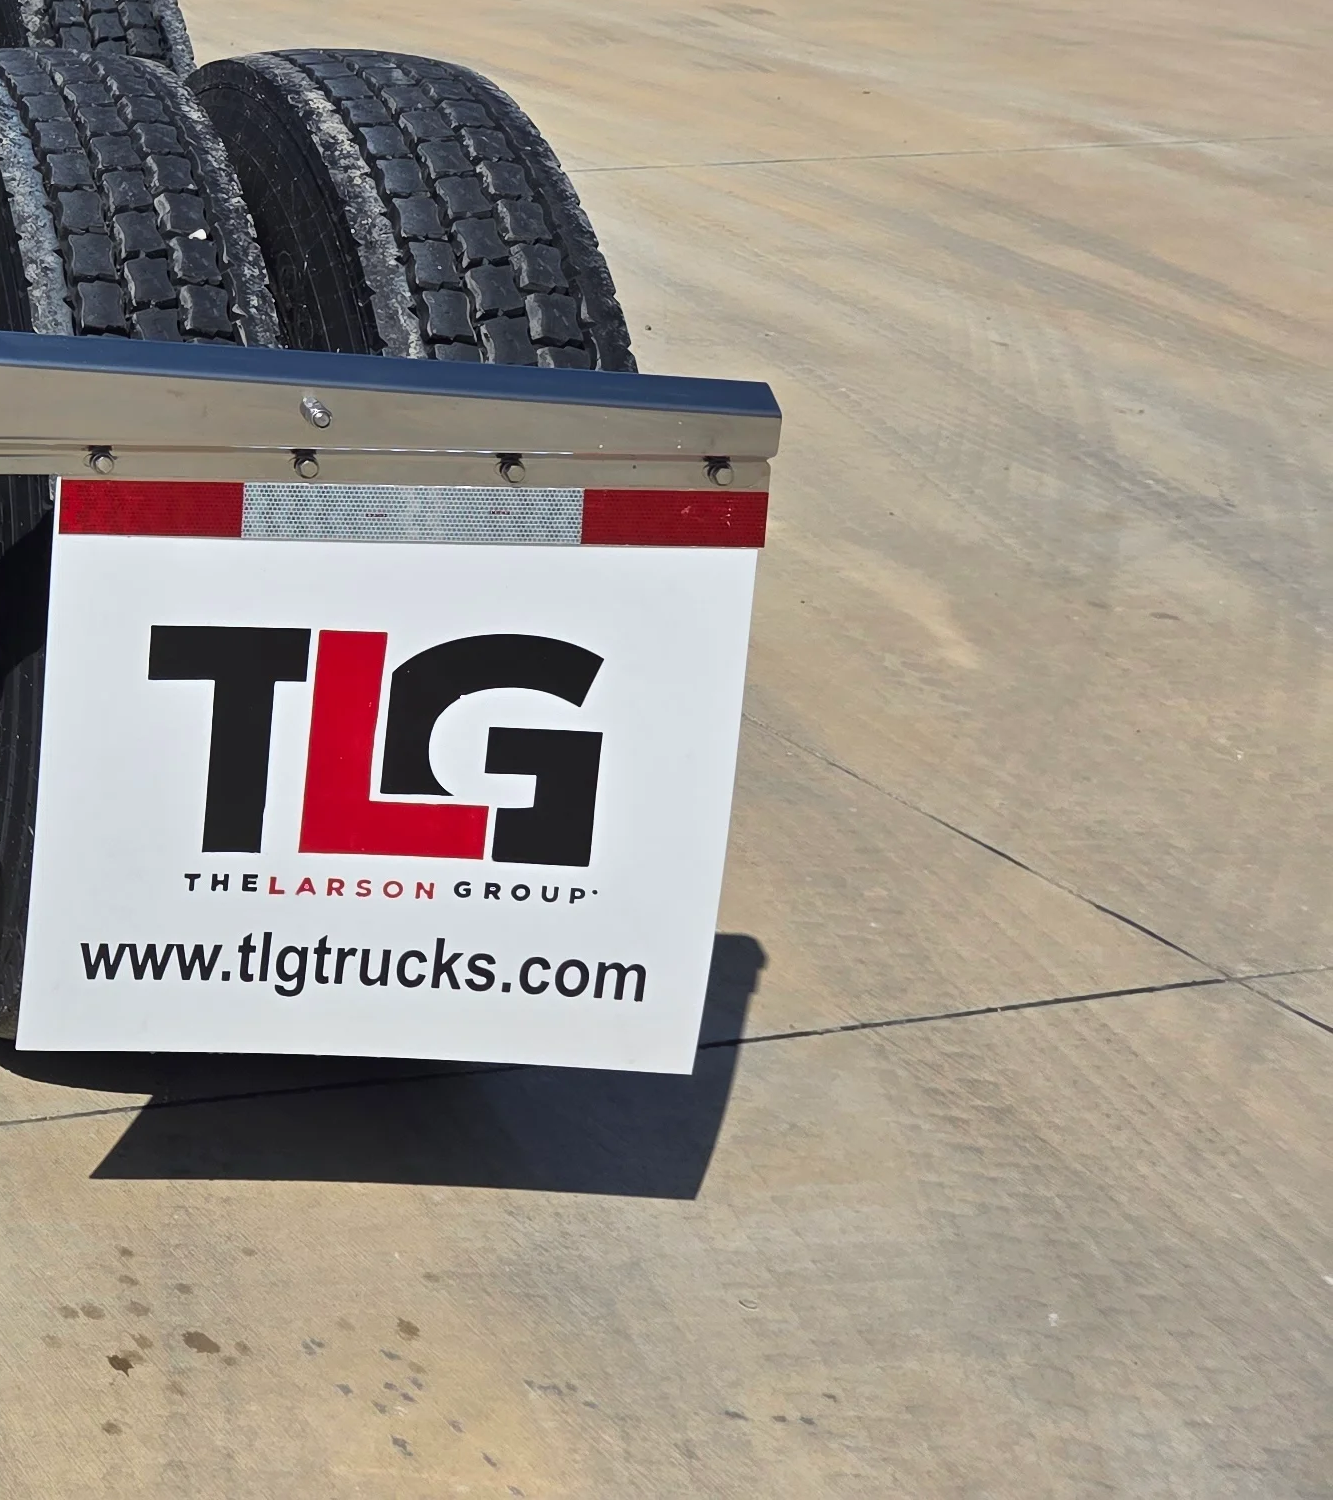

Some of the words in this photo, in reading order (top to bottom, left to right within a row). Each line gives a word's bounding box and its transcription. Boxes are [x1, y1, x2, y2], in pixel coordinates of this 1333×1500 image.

[148, 625, 604, 867] TLG
[184, 873, 259, 893] THE
[268, 876, 435, 900] LARSON
[453, 880, 586, 905] GROUP
[80, 931, 647, 1002] www.tlgtrucks.com
